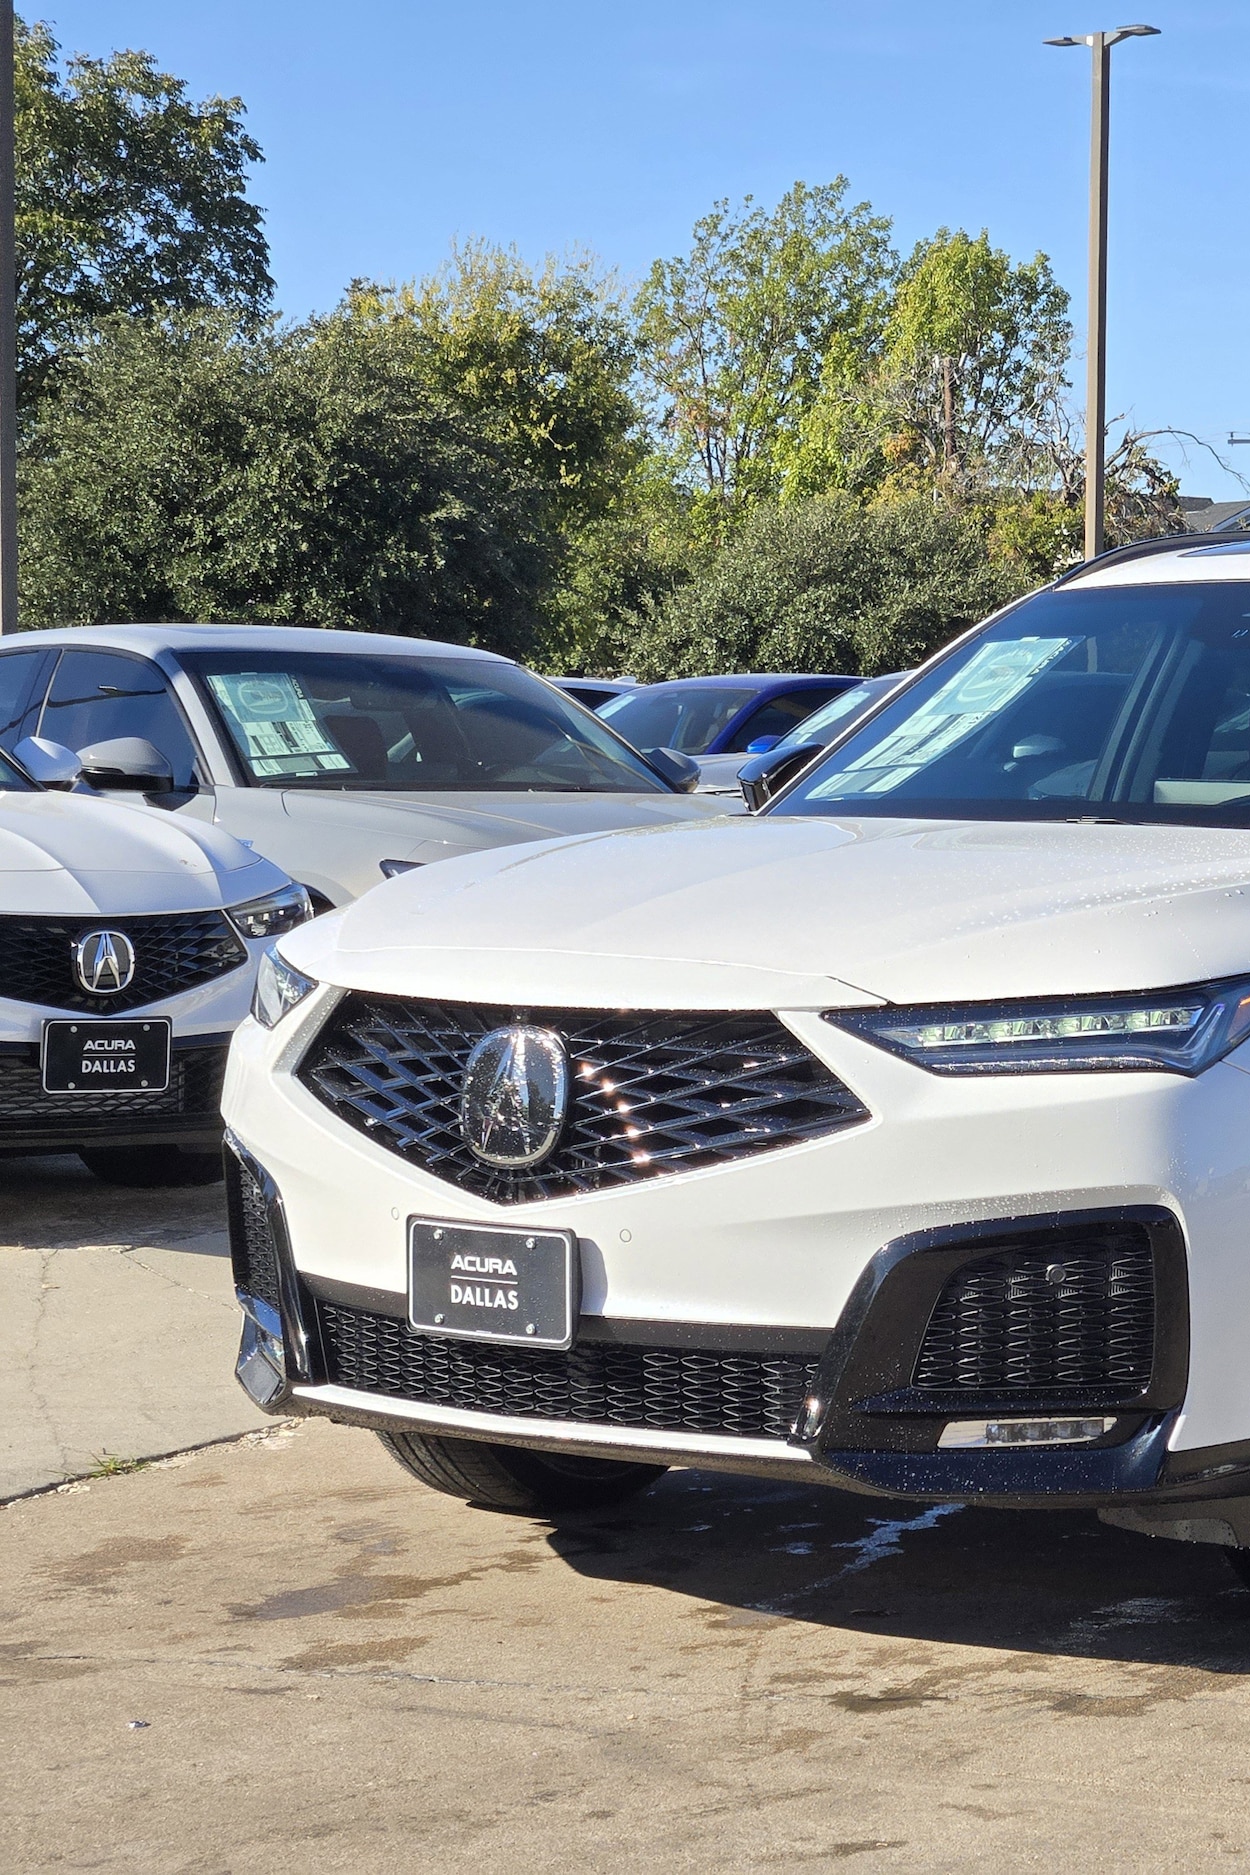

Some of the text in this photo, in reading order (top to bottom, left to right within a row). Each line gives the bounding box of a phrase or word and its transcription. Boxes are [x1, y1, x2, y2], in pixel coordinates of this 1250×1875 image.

[83, 1040, 136, 1051] ACURA
[81, 1060, 136, 1073] DALLAS
[450, 1255, 518, 1276] ACURA
[450, 1284, 519, 1310] DALLAS
